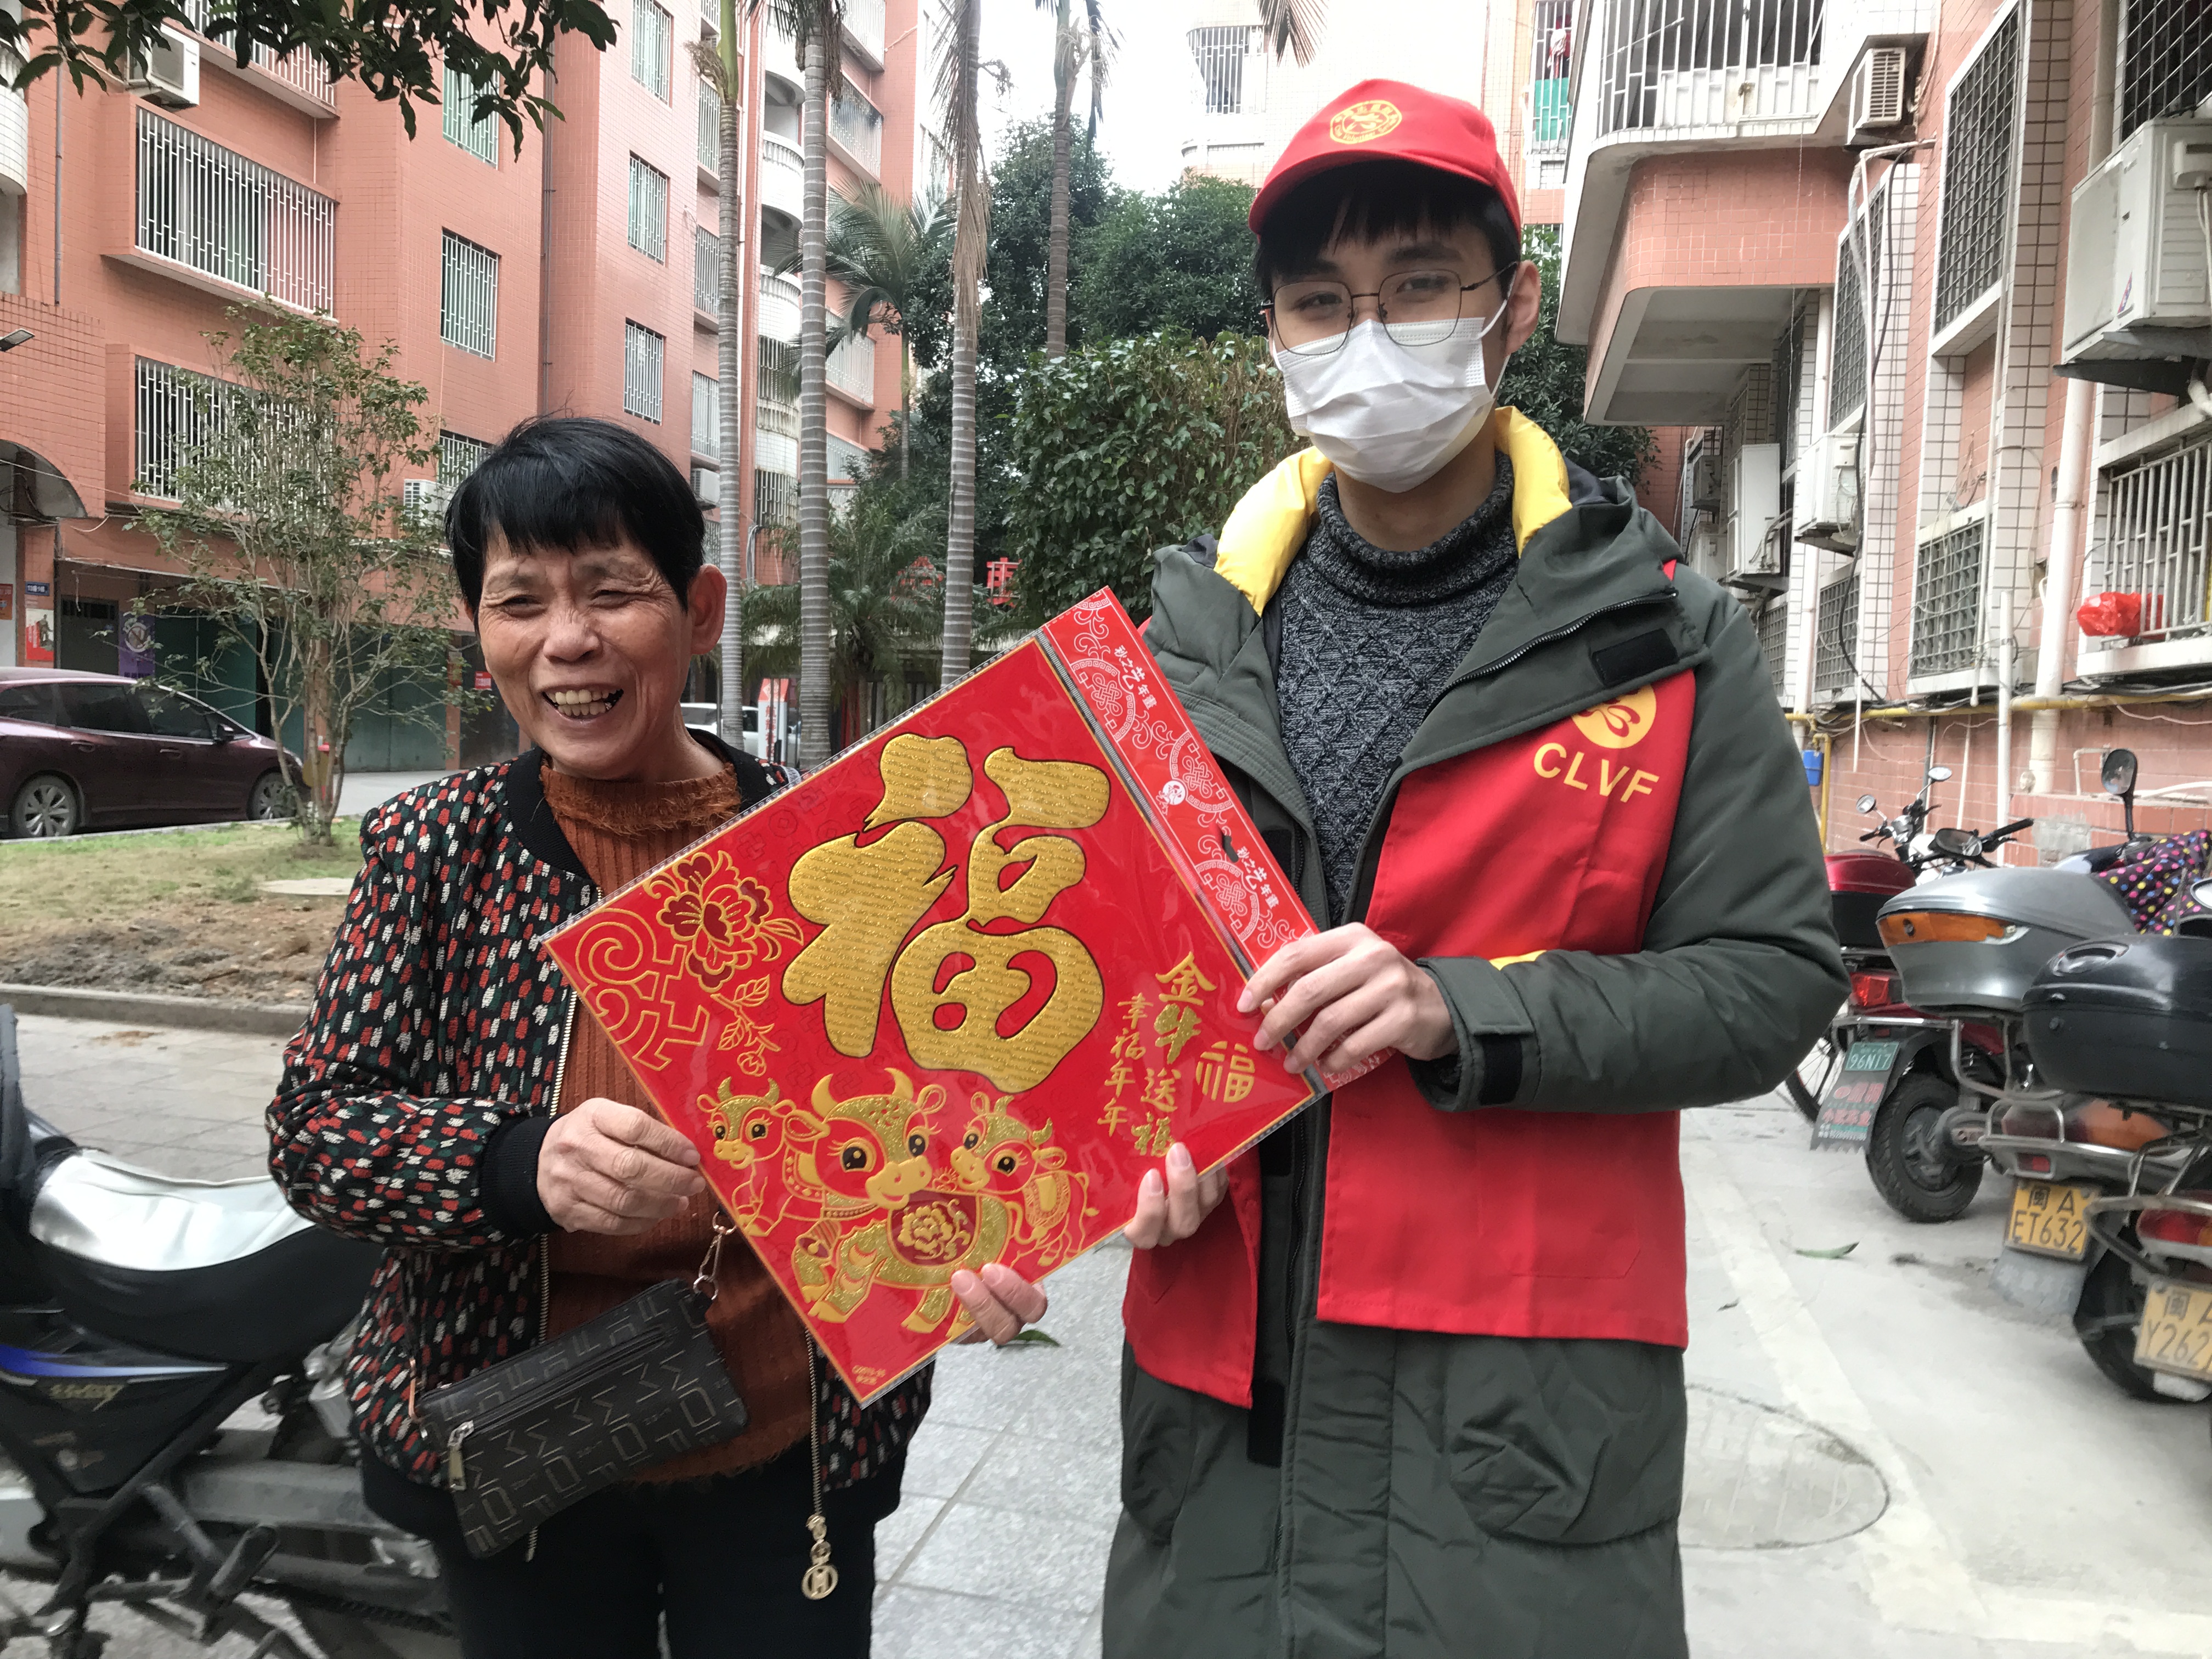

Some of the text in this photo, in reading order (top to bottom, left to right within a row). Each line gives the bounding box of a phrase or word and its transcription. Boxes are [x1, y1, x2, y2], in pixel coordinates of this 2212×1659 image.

[1533, 742, 1660, 804] CLVF
[781, 732, 1111, 1094] 福
[1097, 992, 1154, 1137] 幸福年年
[1131, 951, 1217, 1159] 金牛送福
[1195, 1040, 1256, 1103] 福
[1849, 1053, 1892, 1070] 96N17
[2012, 1209, 2084, 1254] ET632
[2145, 1320, 2212, 1372] Y262
